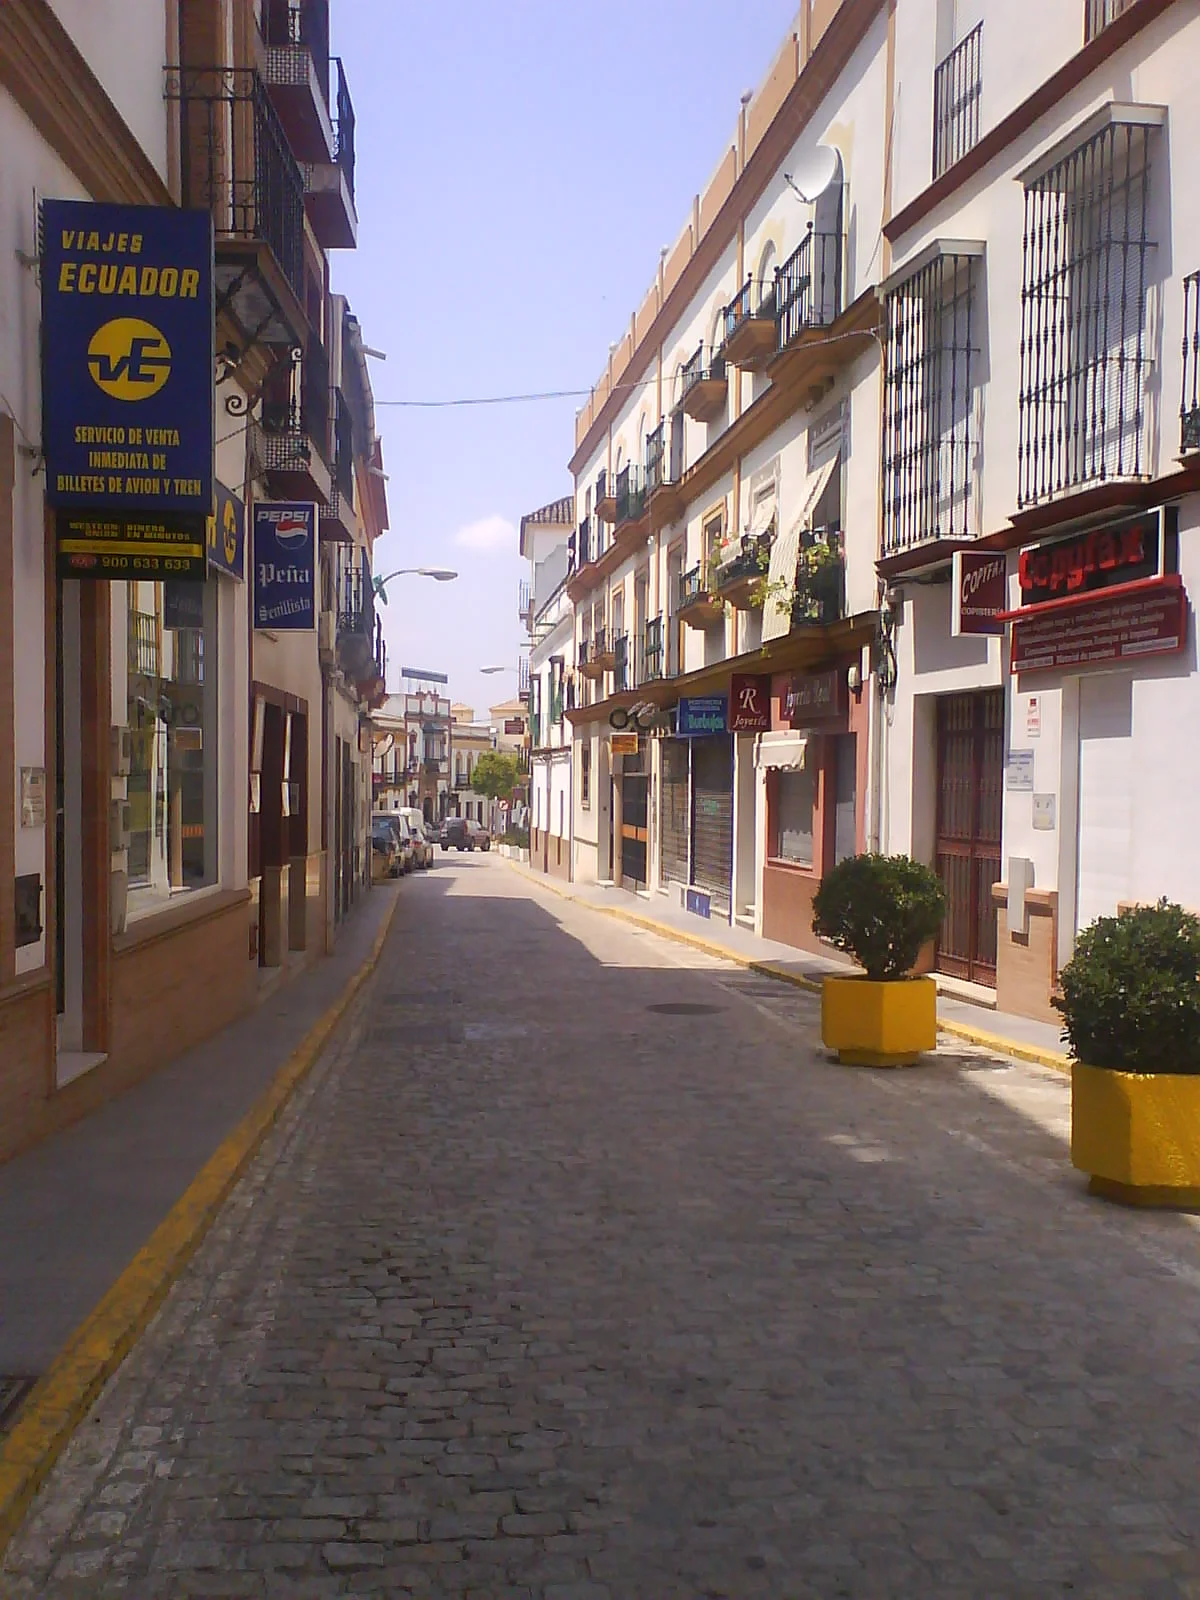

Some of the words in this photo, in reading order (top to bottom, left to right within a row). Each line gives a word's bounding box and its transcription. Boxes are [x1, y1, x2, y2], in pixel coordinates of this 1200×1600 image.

[62, 230, 143, 253] VIAJES
[59, 263, 199, 298] ECUADOR
[75, 426, 125, 444] SERVICIO
[128, 428, 142, 445] DE
[146, 429, 180, 446] VENTA
[89, 451, 149, 469] INMEDIATA
[152, 454, 166, 470] DE
[57, 475, 105, 492] BILLETES
[108, 477, 122, 493] DE
[125, 477, 160, 494] AVION
[163, 479, 171, 495] Y
[174, 480, 201, 496] TREN
[257, 511, 310, 522] PEPSI
[102, 556, 128, 568] 900
[133, 558, 159, 569] 633
[164, 559, 190, 570] 633
[259, 563, 309, 587] Peña
[739, 688, 761, 714] R
[732, 714, 767, 728] Joyería
